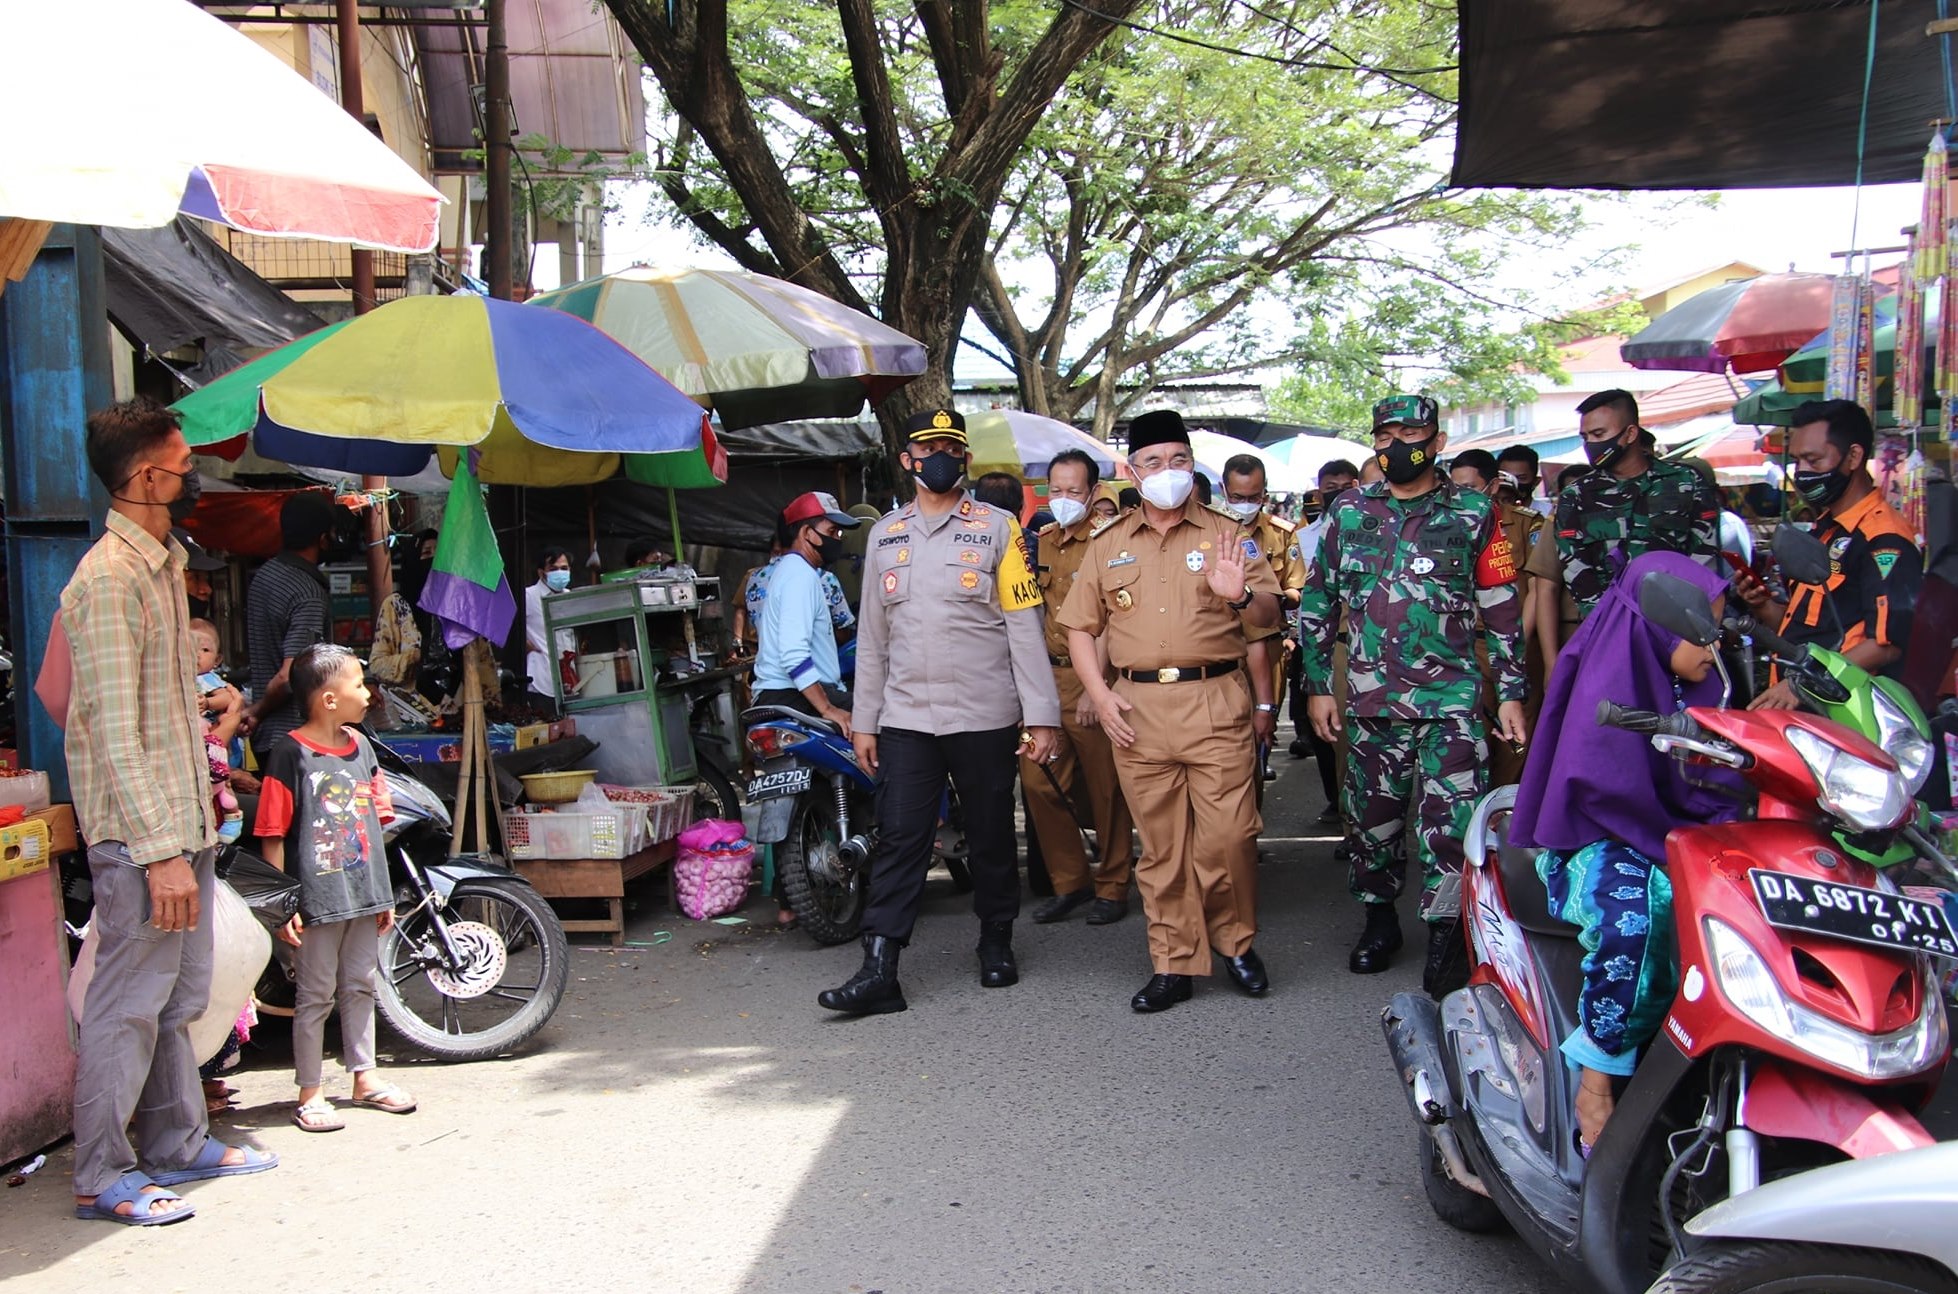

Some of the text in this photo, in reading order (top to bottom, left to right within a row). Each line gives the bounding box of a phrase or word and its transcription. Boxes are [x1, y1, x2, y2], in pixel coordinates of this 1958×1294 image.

[953, 533, 993, 547] POLRI
[1759, 875, 1940, 931] DA 6872 KI
[1668, 1015, 1693, 1050] YAMAHA
